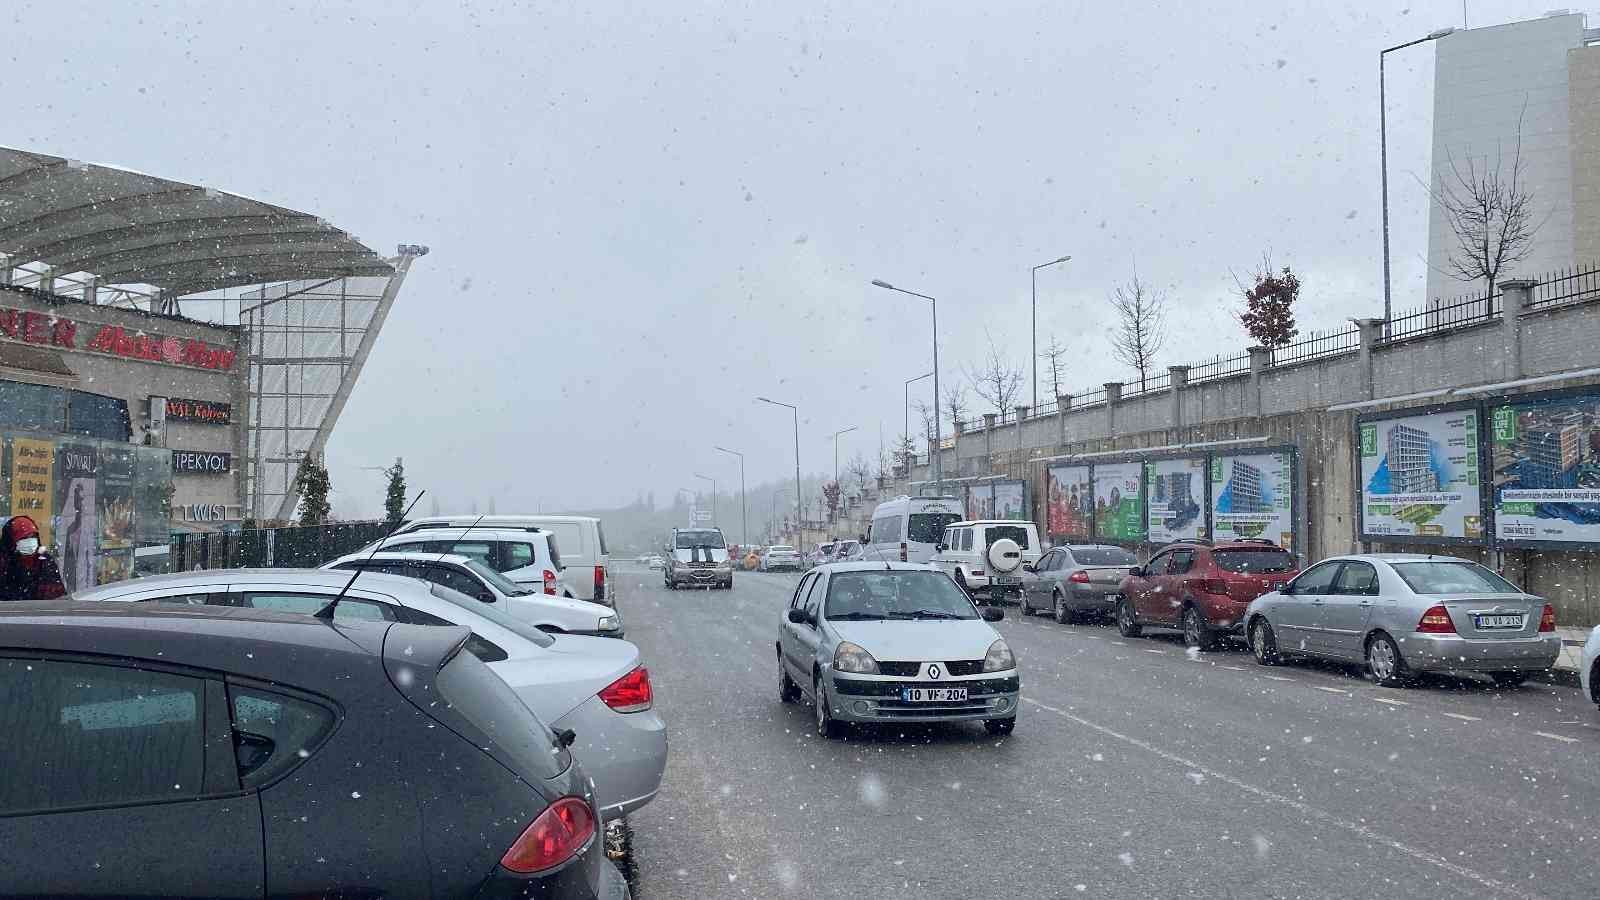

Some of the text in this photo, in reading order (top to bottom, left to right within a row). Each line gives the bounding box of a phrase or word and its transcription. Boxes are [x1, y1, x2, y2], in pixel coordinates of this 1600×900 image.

[909, 689, 967, 701] 10 VF 204
